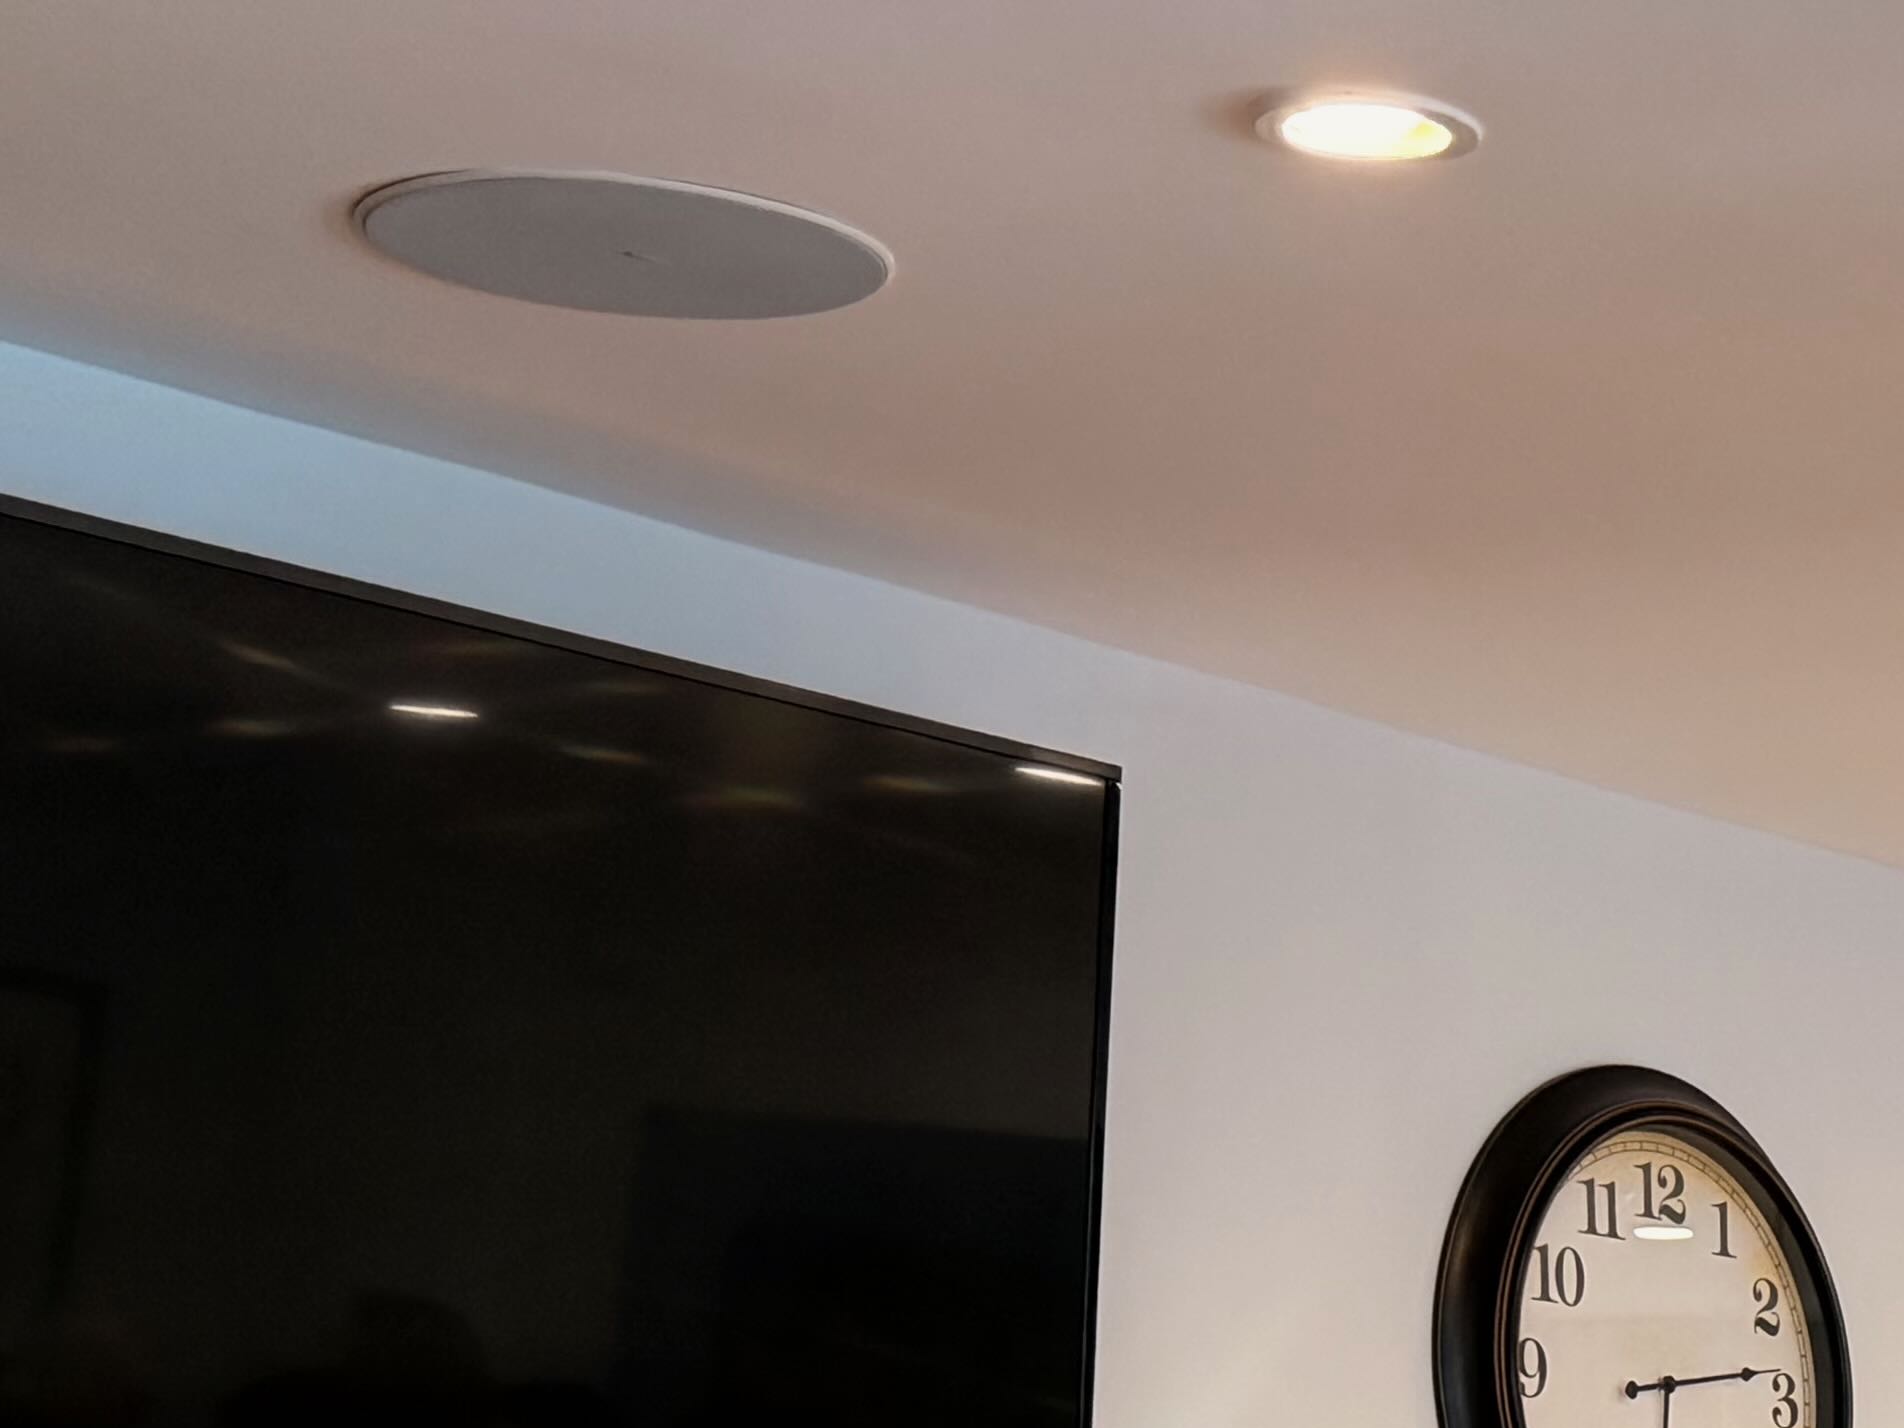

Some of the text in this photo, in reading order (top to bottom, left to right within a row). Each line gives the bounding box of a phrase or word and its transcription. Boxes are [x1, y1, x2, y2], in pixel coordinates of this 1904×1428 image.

[1578, 1178, 1626, 1240] 11
[1634, 1161, 1687, 1225] 12
[1711, 1201, 1737, 1258] 1
[1530, 1243, 1585, 1306] 10
[1753, 1277, 1780, 1336] 2
[1519, 1337, 1547, 1398] 9
